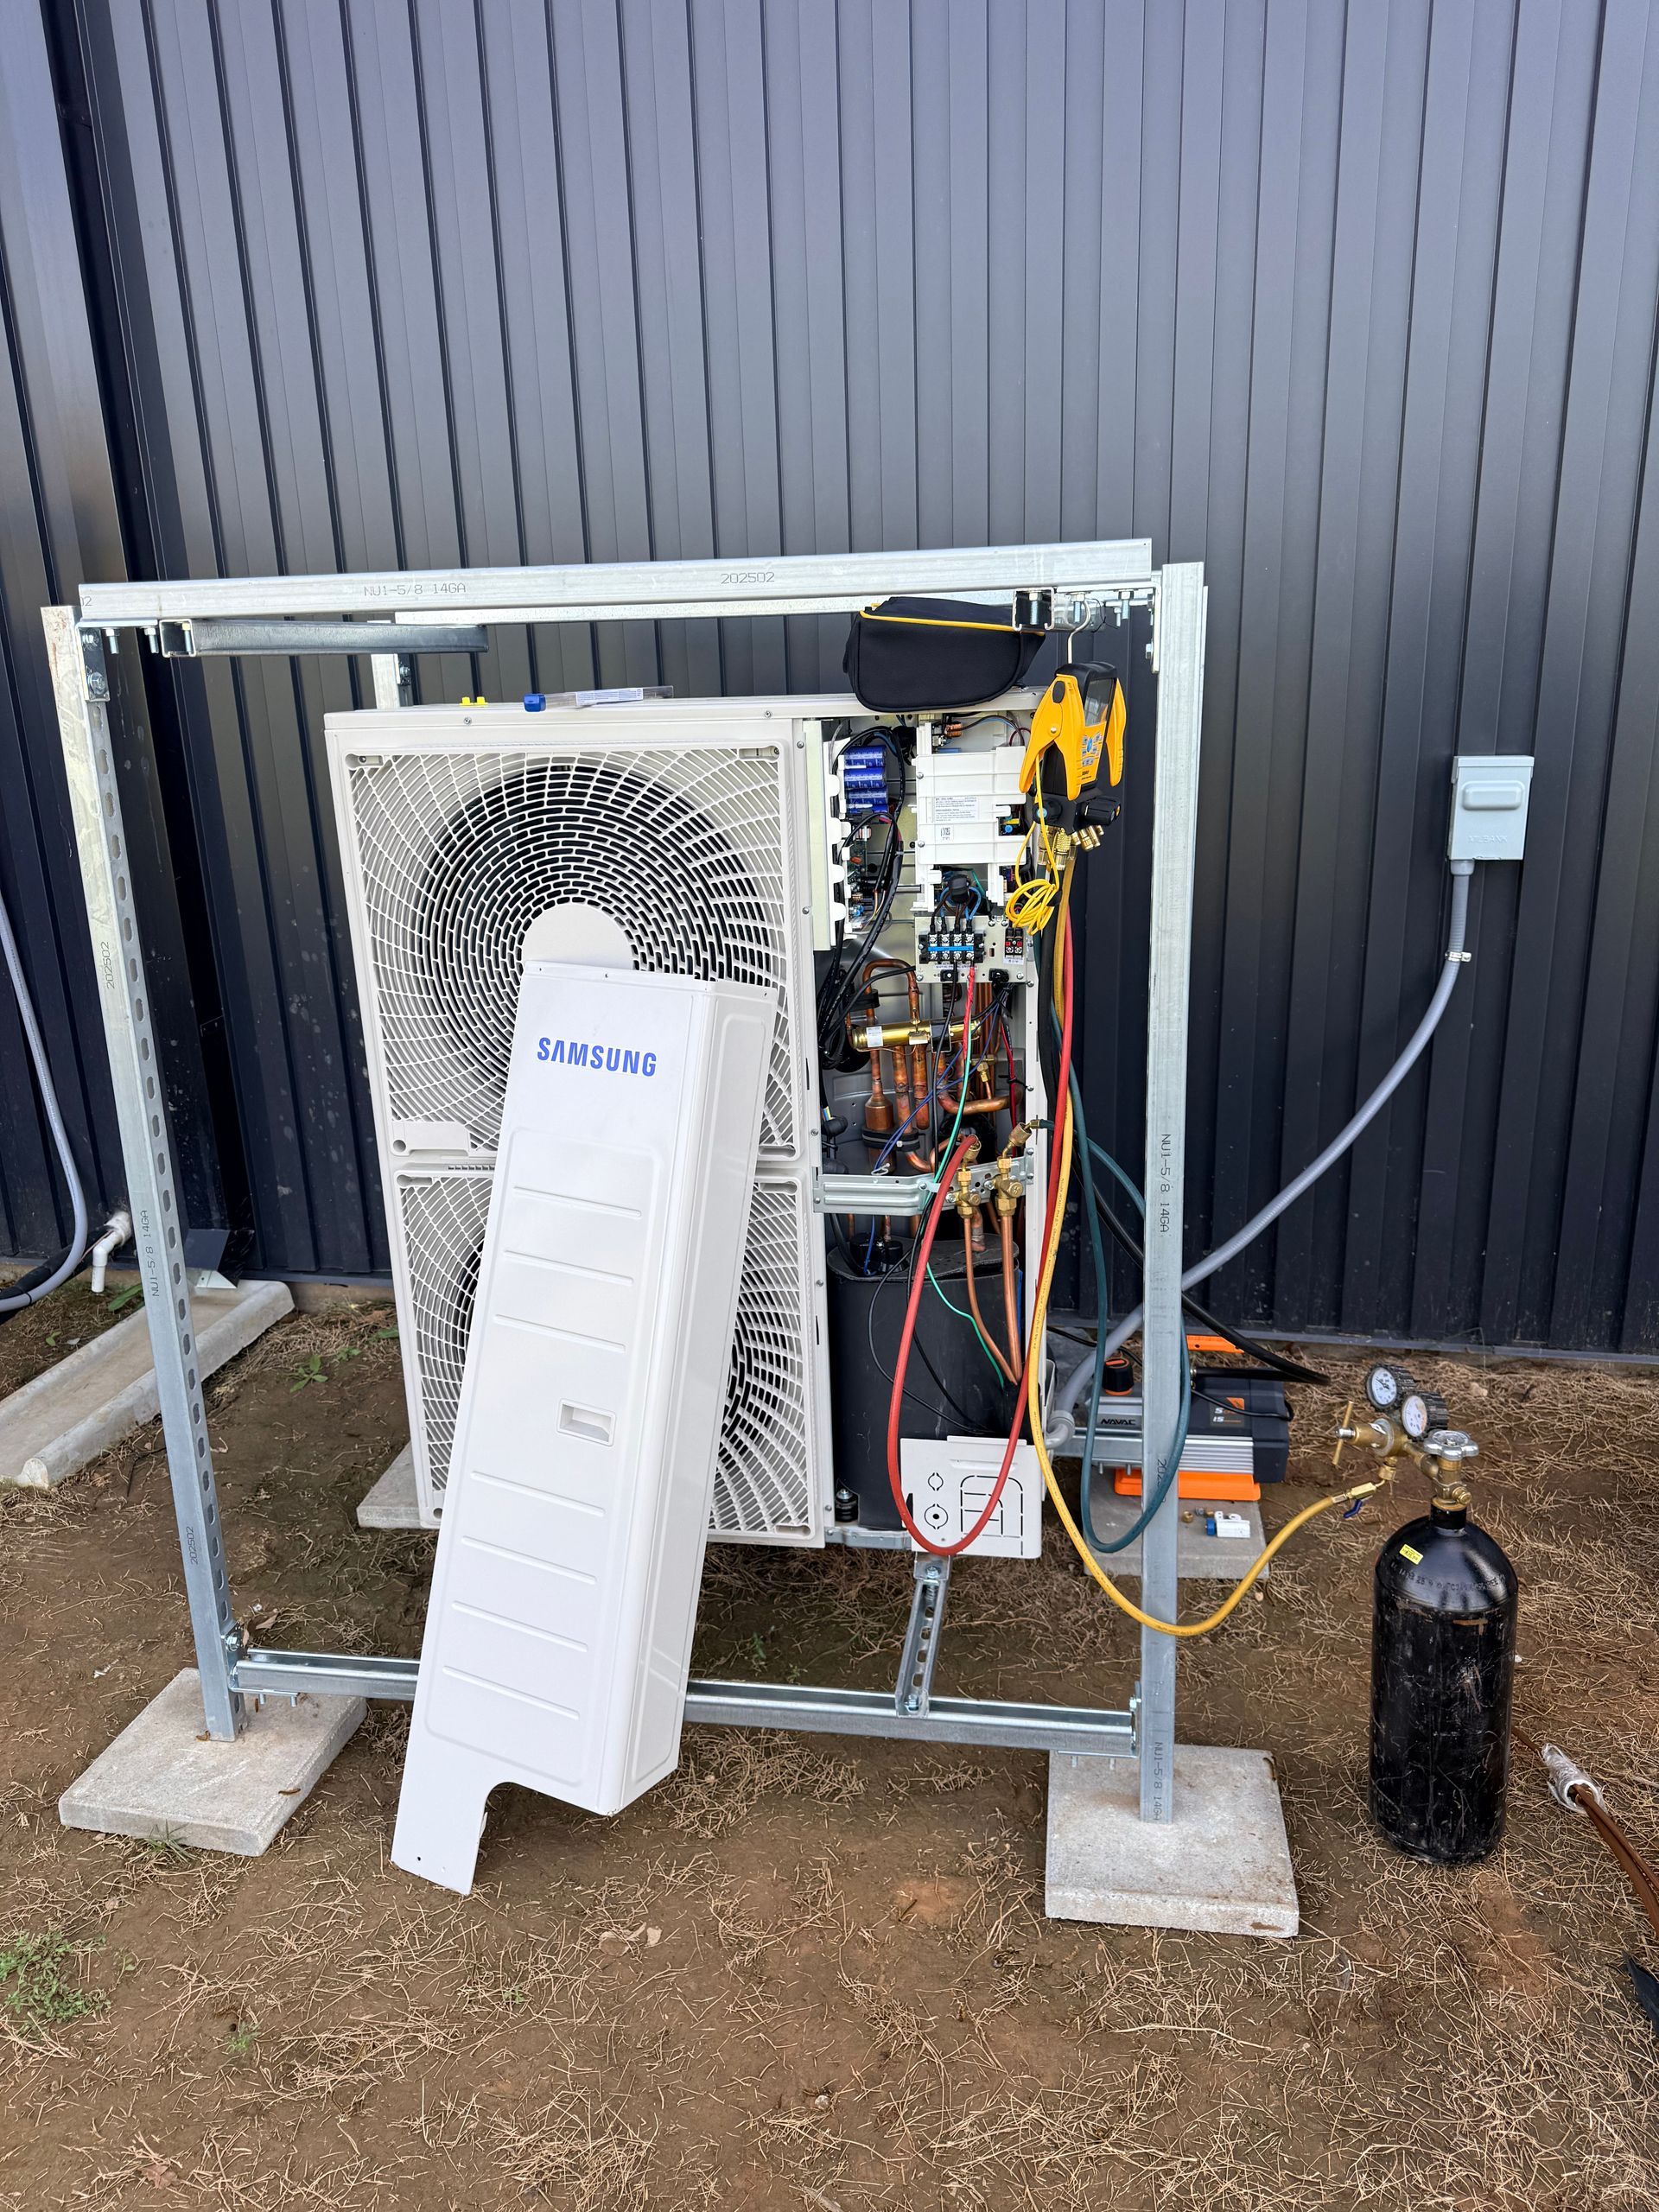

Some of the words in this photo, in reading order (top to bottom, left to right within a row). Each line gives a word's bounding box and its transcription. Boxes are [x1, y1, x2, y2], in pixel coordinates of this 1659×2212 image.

[364, 584, 423, 596] NU1-5/8
[433, 582, 467, 594] 14GA
[720, 571, 775, 584] 202502
[100, 941, 115, 989] 202502
[537, 1037, 657, 1077] SAMSUNG
[1160, 1134, 1172, 1192] NU1-5/8
[140, 1210, 152, 1238] 14GA
[1160, 1202, 1171, 1233] 14GA
[145, 1246, 160, 1297] NU1-5/8
[186, 1526, 199, 1565] 202502
[1154, 1741, 1163, 1789] NU1-5/8
